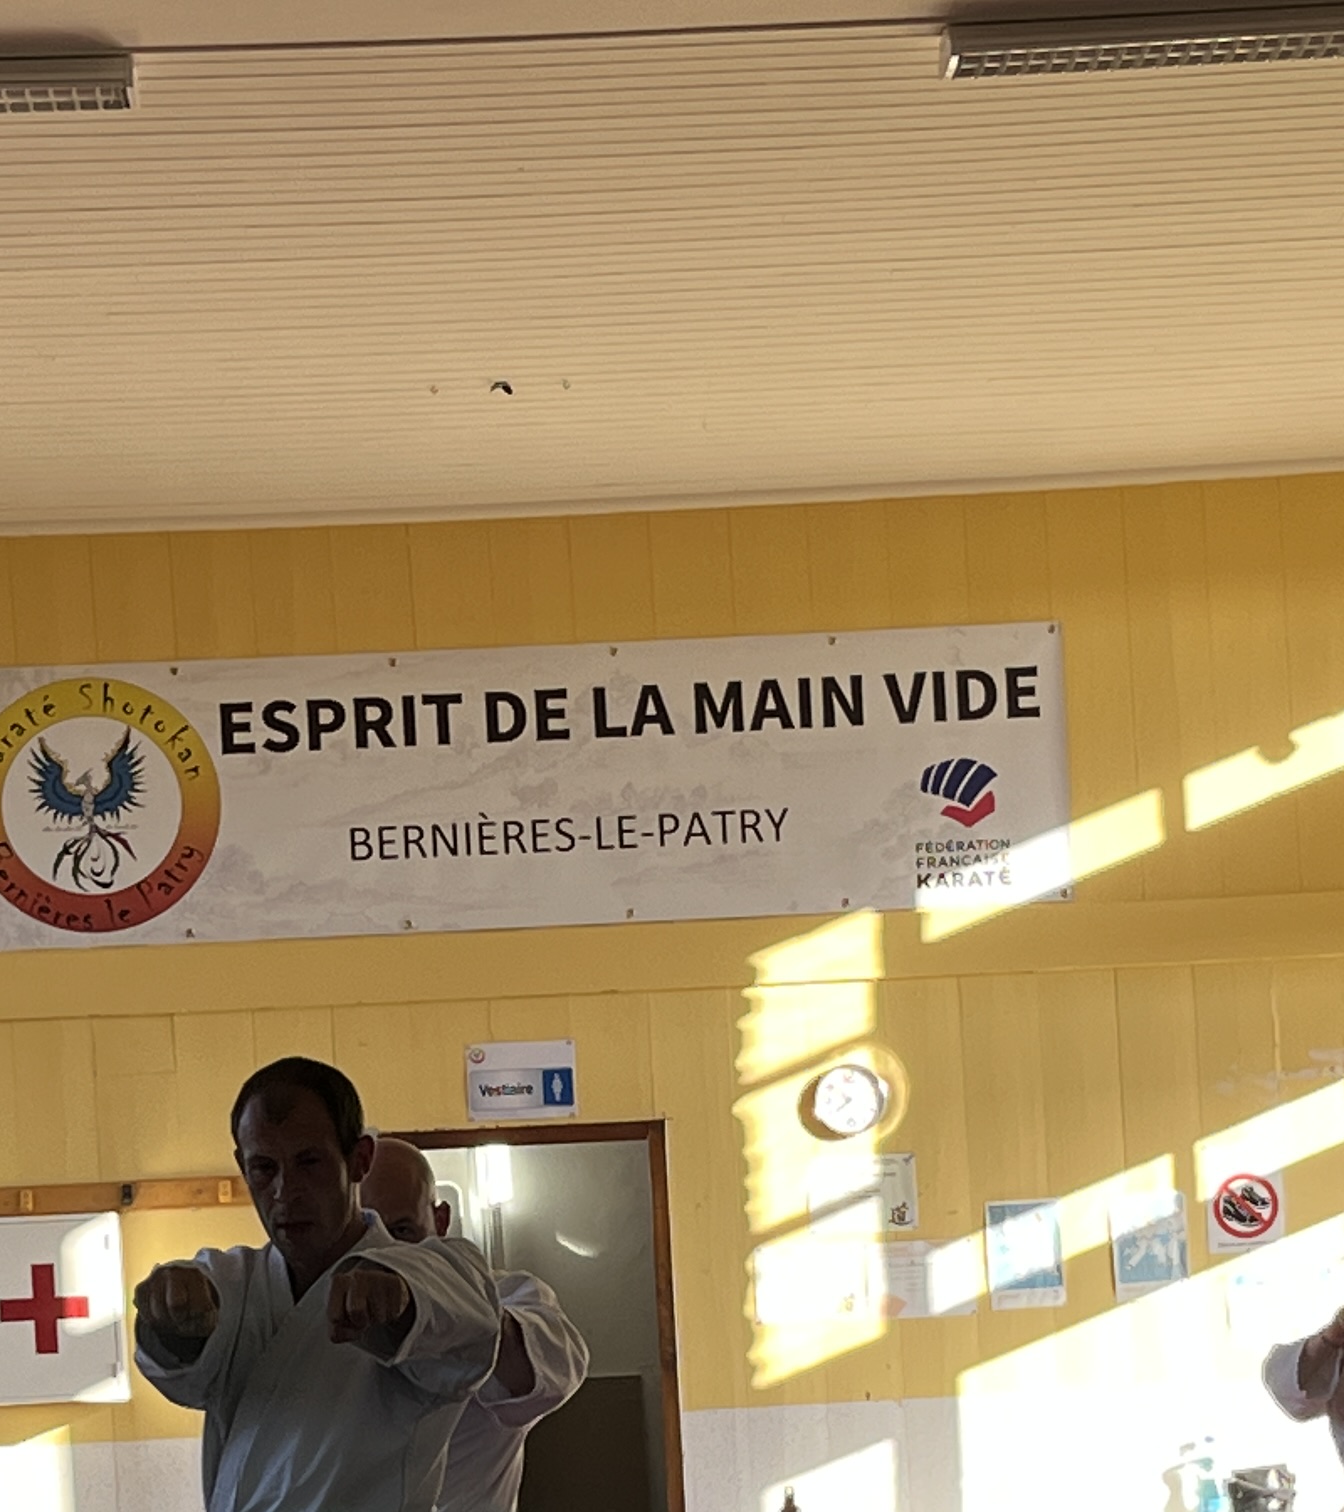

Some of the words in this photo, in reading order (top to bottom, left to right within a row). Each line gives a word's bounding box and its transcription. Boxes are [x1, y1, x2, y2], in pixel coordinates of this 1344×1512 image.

[78, 682, 201, 782] Shotokan
[218, 693, 462, 756] ESPRIT
[484, 687, 571, 744] DE
[592, 684, 675, 739] LA
[692, 674, 865, 735] MAIN
[882, 665, 1041, 725] VIDE
[349, 807, 789, 863] BERNIÈRES-LE-PATRY
[915, 839, 1011, 854] FÉDÉRATION
[103, 898, 132, 928] le
[135, 845, 205, 909] Patry
[916, 867, 1012, 889] KARATÉ
[478, 1082, 534, 1097] Vestiaire
